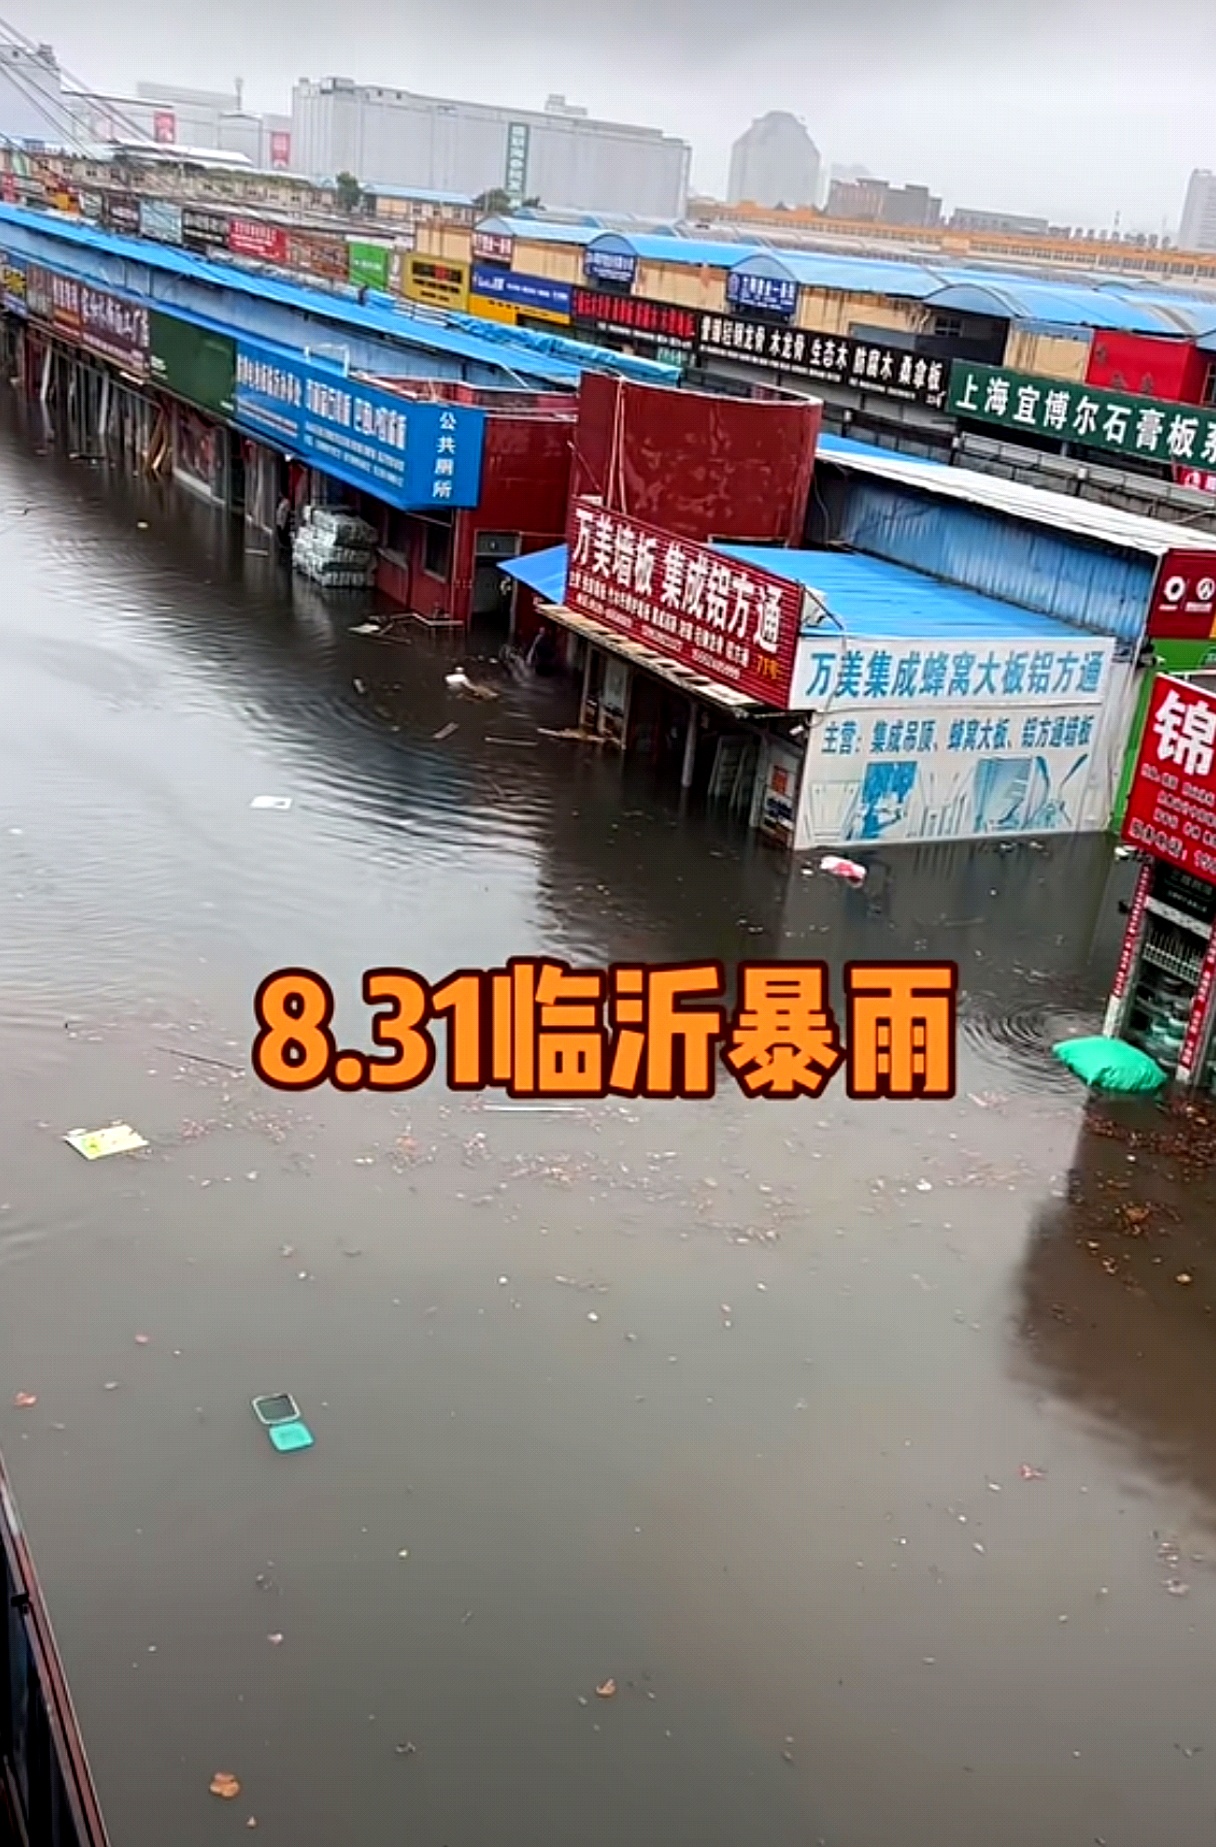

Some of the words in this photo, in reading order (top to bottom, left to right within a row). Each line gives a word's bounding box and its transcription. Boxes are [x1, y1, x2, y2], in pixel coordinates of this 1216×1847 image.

[432, 411, 457, 498] 公共厕所
[572, 508, 658, 596] 万美墙板
[660, 541, 784, 653] 集成铝方通
[805, 650, 1105, 697] 万美集成蜂窝大板铝方通
[1153, 689, 1216, 776] 锦
